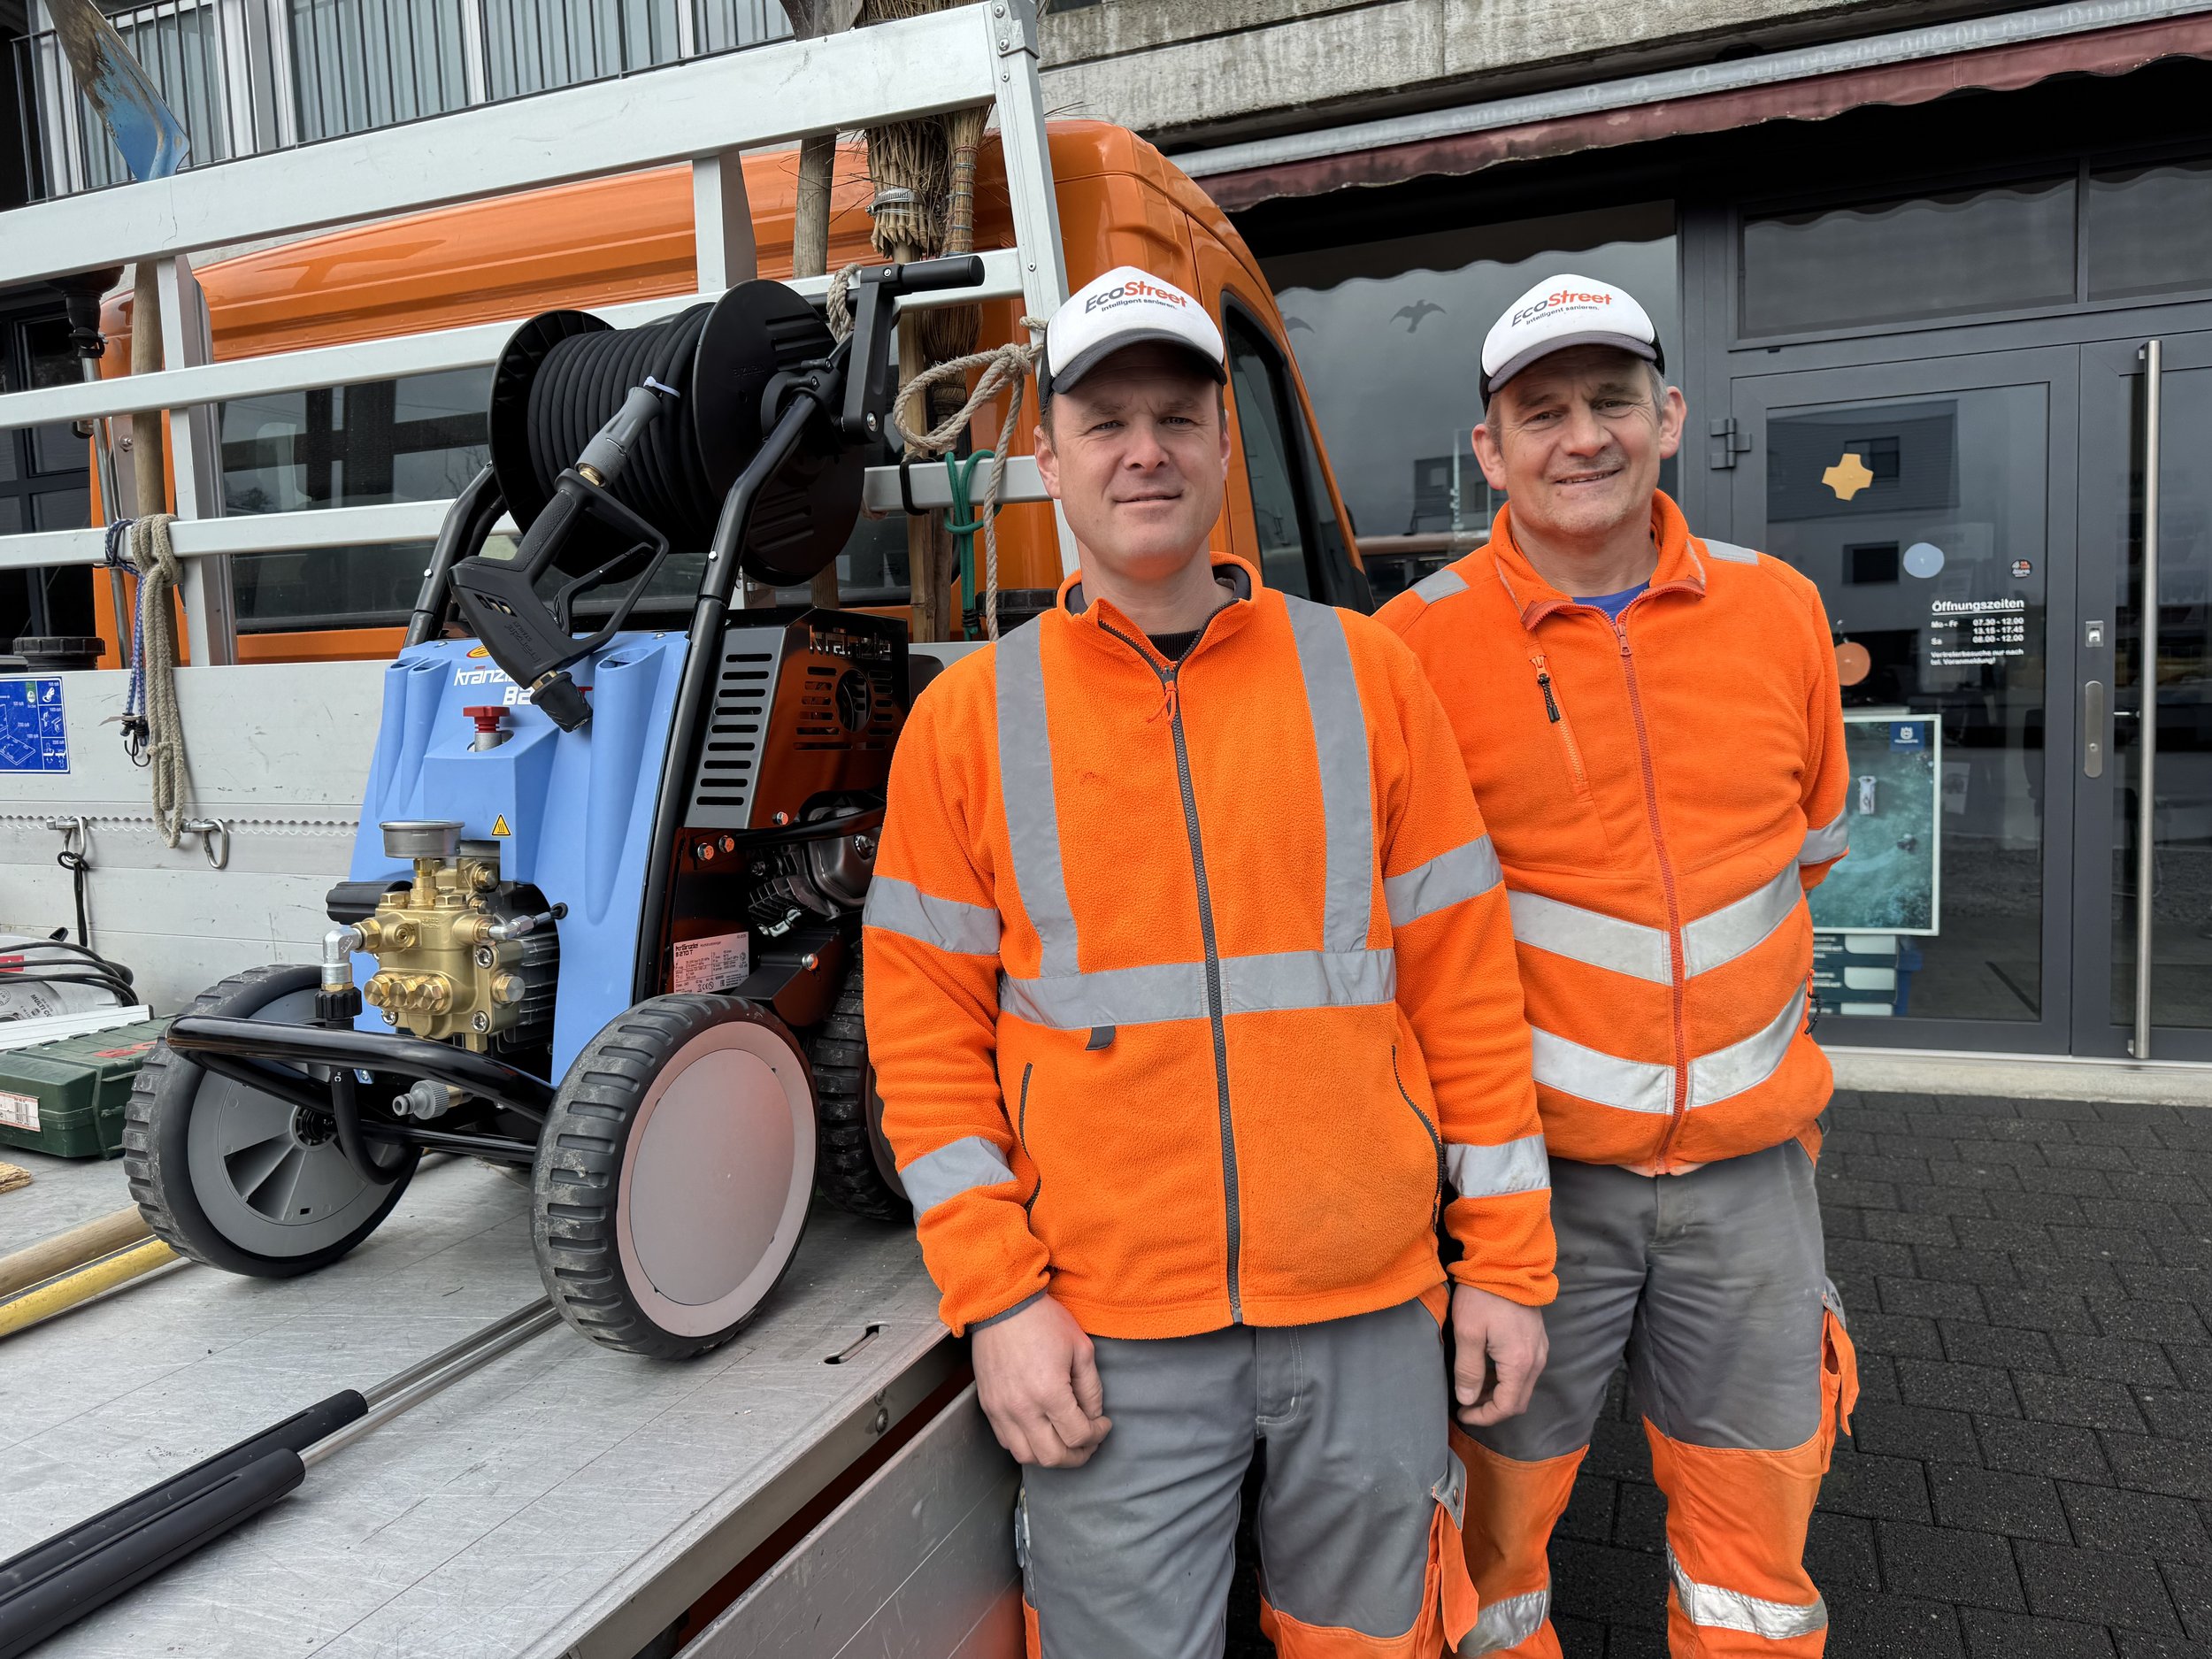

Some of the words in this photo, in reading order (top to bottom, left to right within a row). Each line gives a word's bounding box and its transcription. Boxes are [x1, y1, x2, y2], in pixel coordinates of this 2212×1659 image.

[1085, 280, 1187, 313] EcoStreet
[1102, 298, 1142, 311] intelligent
[1512, 290, 1612, 327] EcoStreet
[1526, 307, 1563, 325] intelligent
[1932, 599, 2024, 612] Öffnungszeiten
[30, 994, 47, 1010] MULTI
